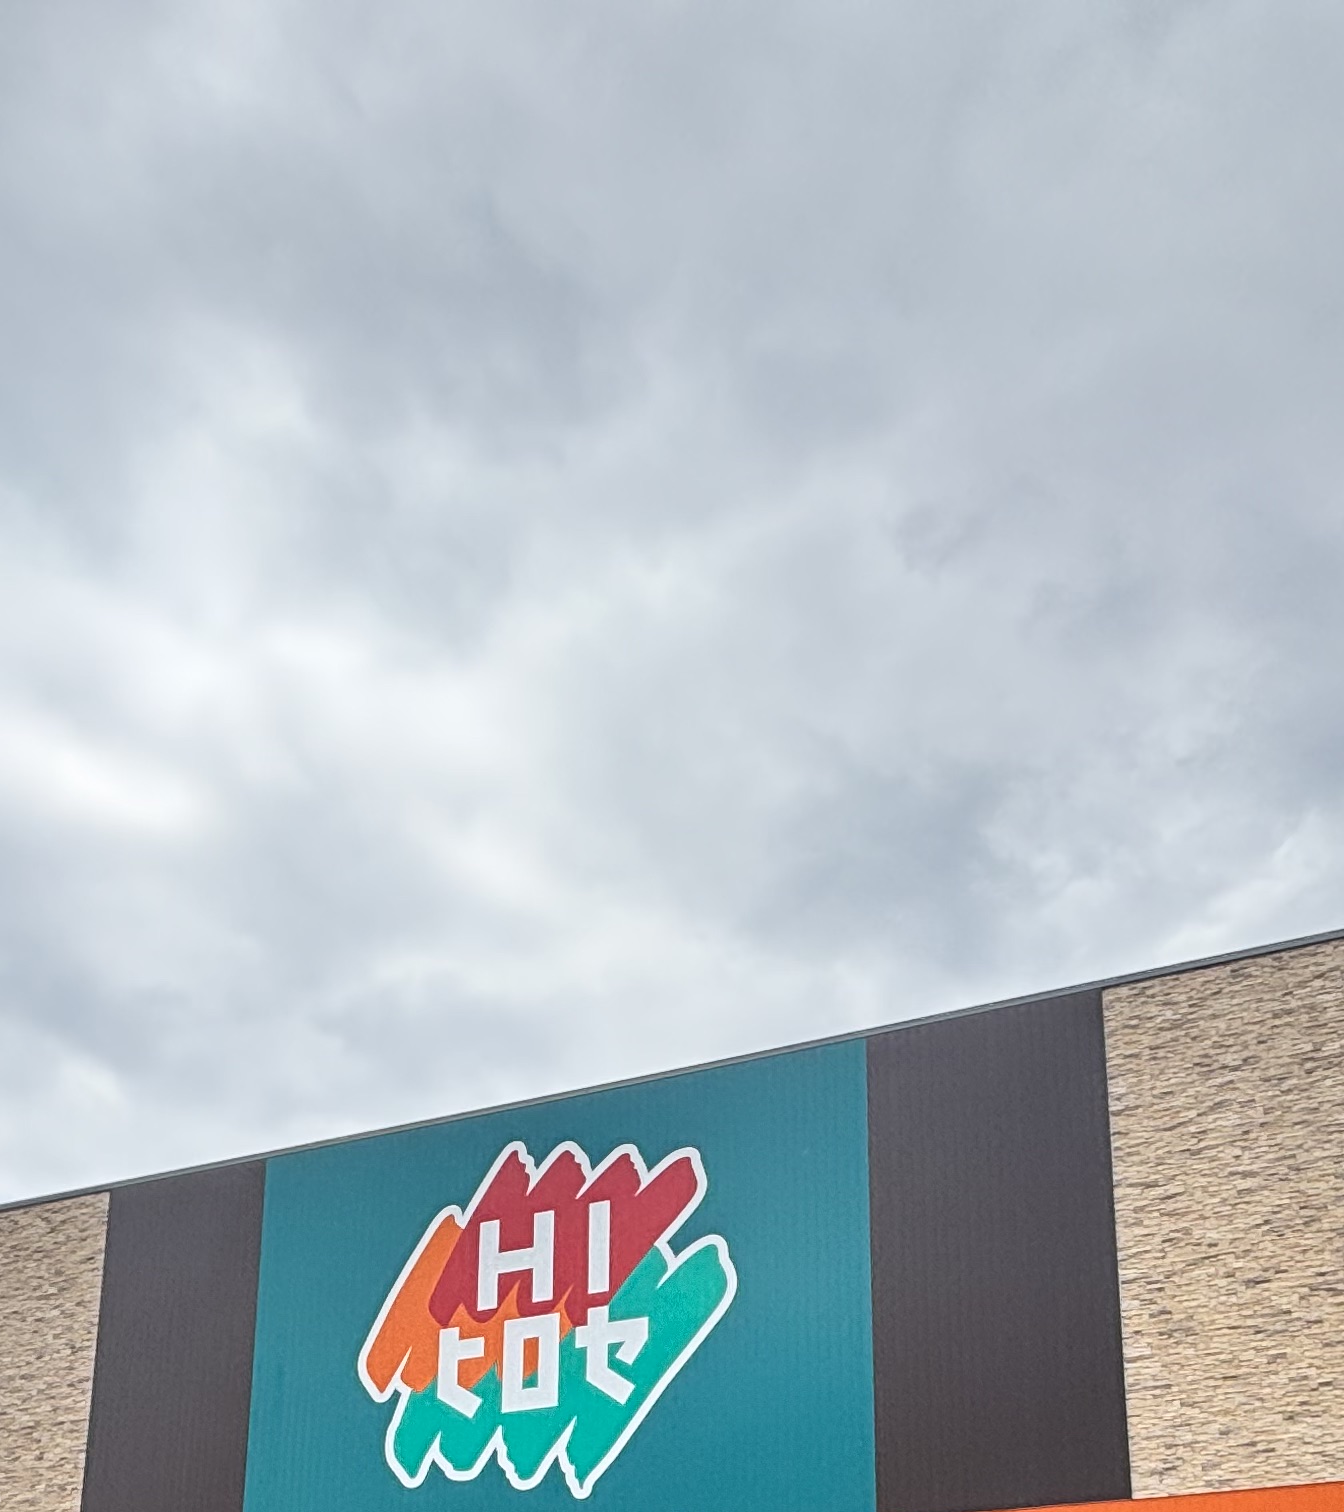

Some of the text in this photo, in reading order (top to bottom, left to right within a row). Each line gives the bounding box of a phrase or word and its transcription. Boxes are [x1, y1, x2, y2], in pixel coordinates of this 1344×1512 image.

[477, 1200, 610, 1311] HI
[437, 1305, 649, 1418] ヒロセ
